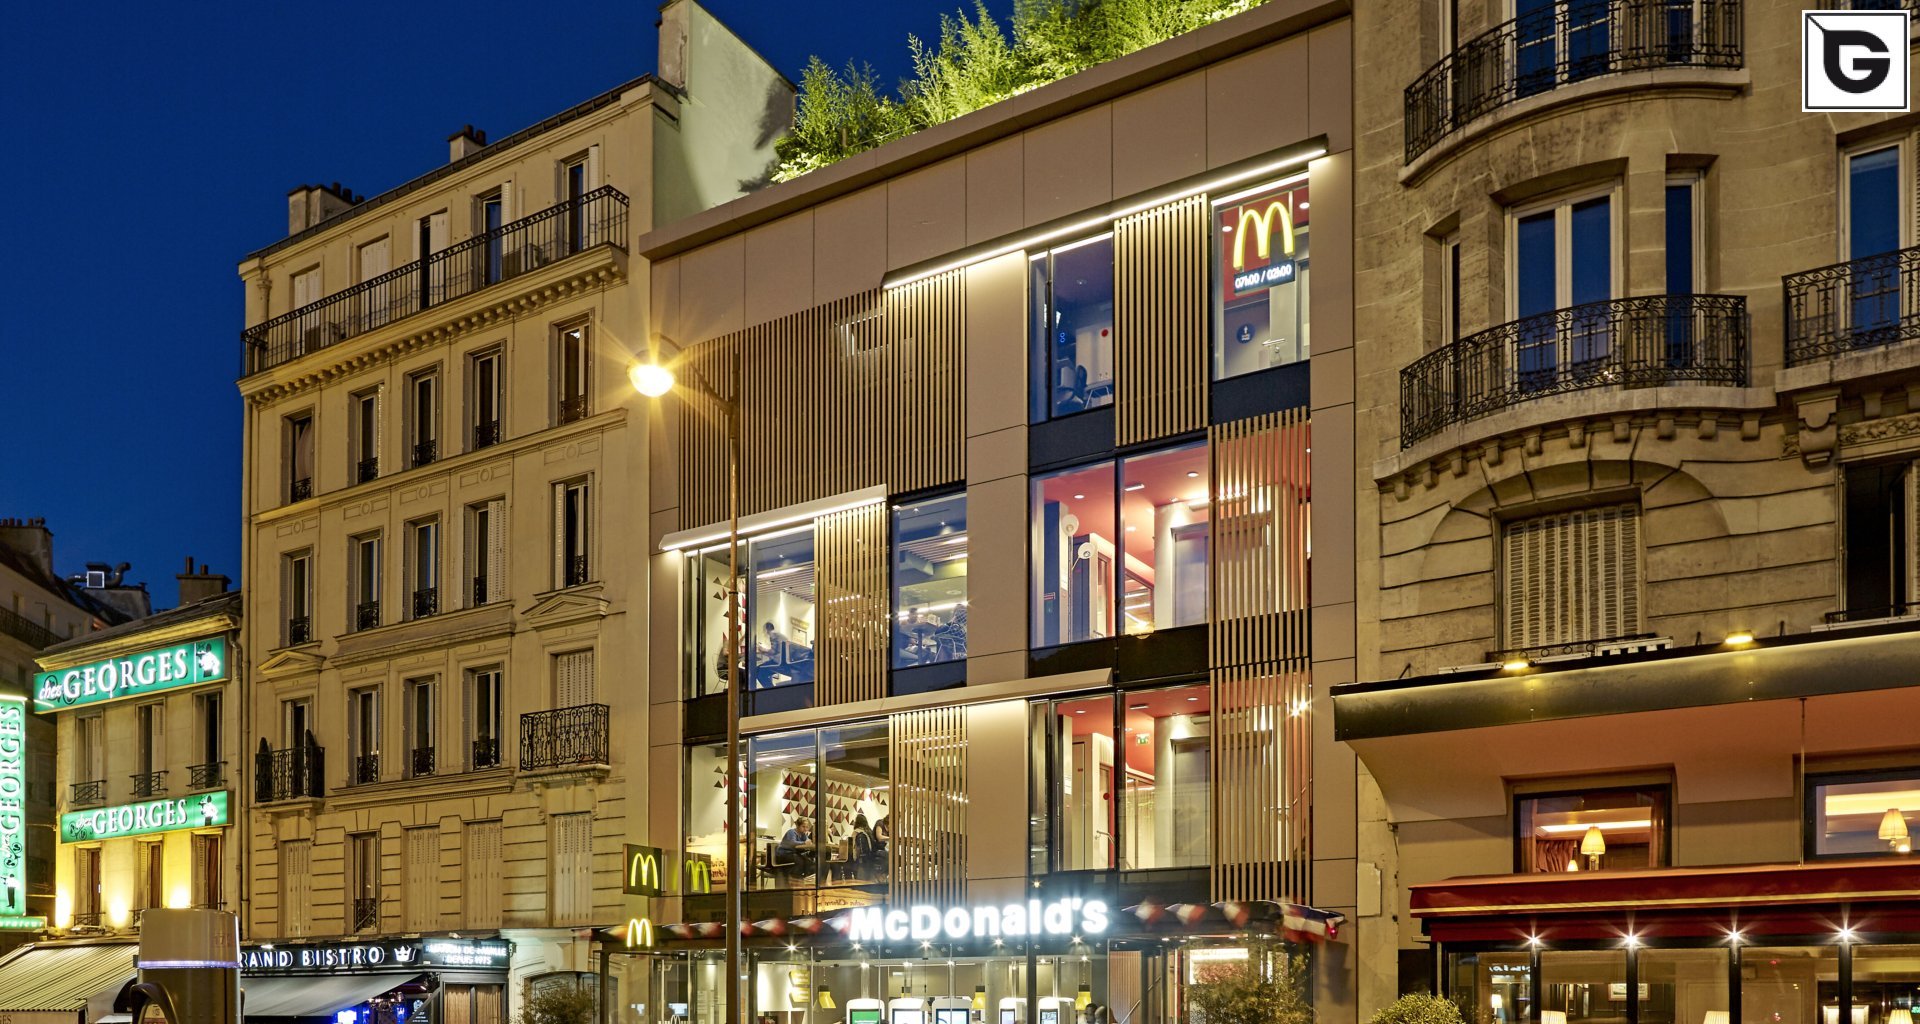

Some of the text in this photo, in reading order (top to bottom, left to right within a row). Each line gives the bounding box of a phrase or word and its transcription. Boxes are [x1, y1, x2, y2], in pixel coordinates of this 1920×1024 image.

[1234, 273, 1260, 289] 07h00
[1266, 264, 1292, 280] 02h00
[62, 649, 188, 698] GEORGES
[0, 706, 21, 834] GEORGES
[92, 799, 188, 835] GEORGES
[848, 898, 1109, 941] McDonald's
[302, 947, 384, 967] BISTRO
